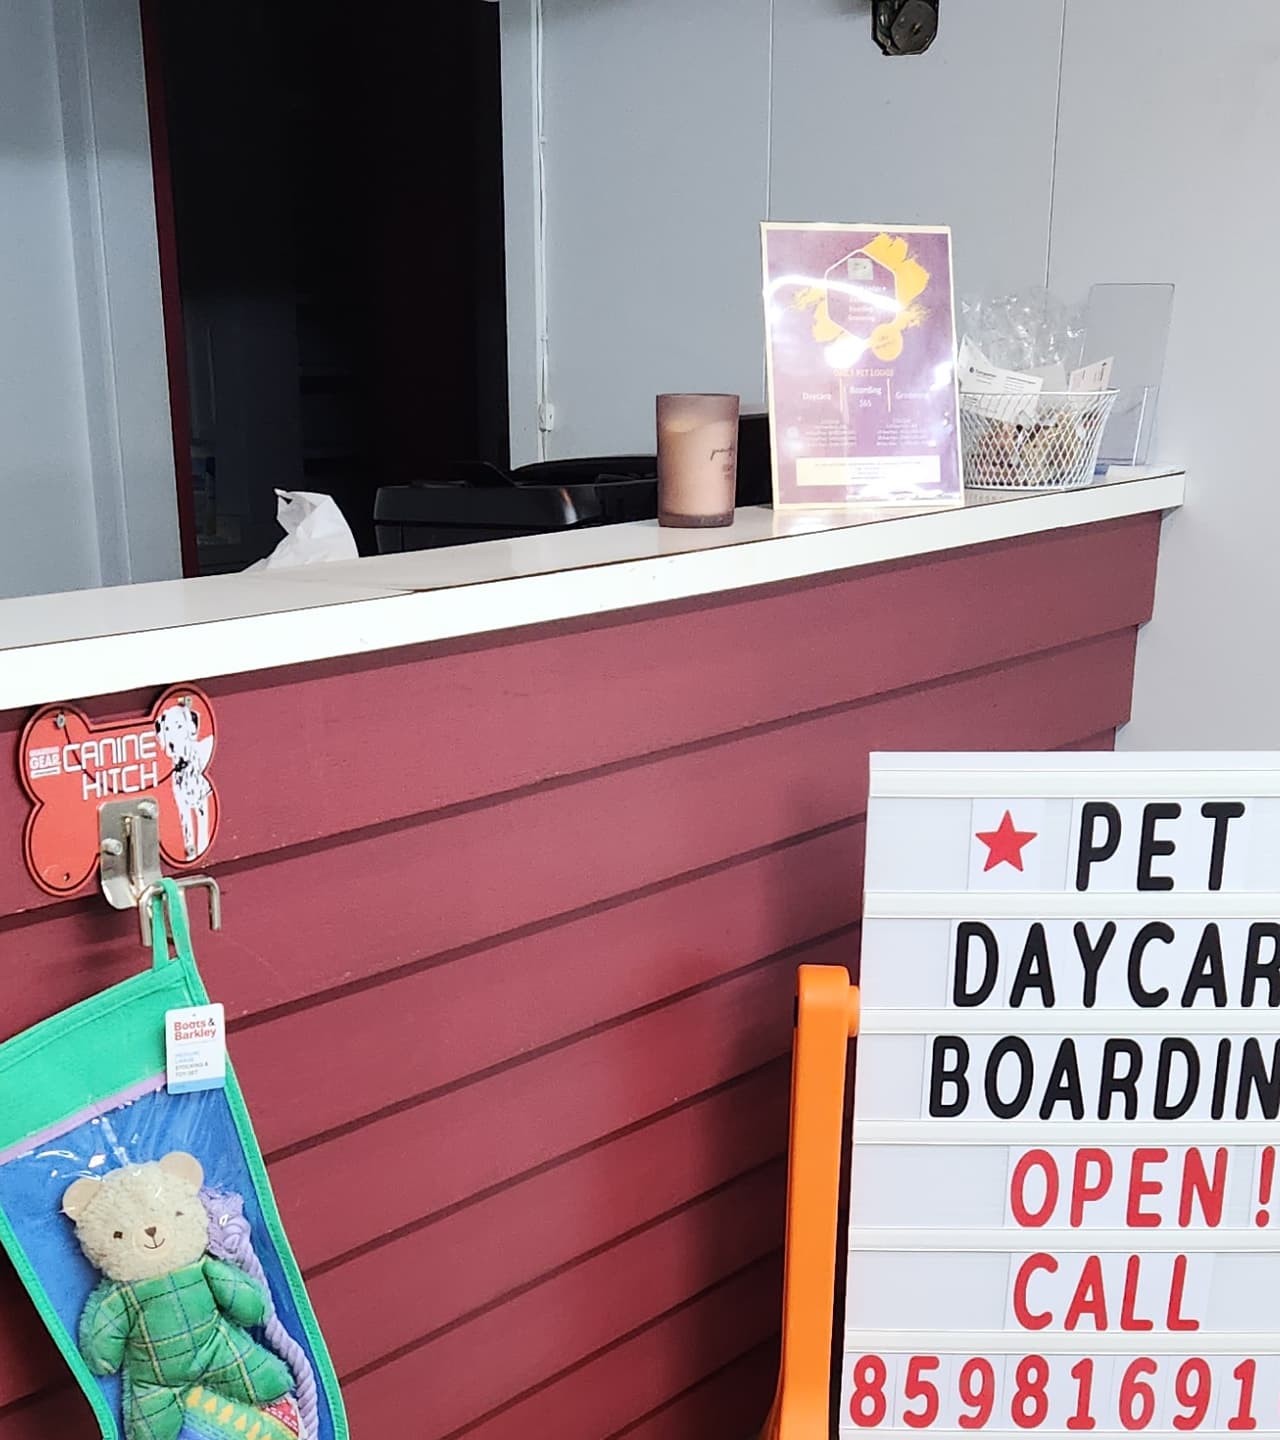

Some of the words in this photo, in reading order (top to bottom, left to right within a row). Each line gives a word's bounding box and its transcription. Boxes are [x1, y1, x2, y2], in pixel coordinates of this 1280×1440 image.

[29, 753, 61, 770] GEAR
[62, 730, 157, 773] CANINE
[82, 760, 158, 801] HITCH
[1076, 802, 1244, 891] PET
[175, 1029, 216, 1040] Barkley
[208, 1018, 215, 1027] &
[1014, 1253, 1199, 1331] CALL
